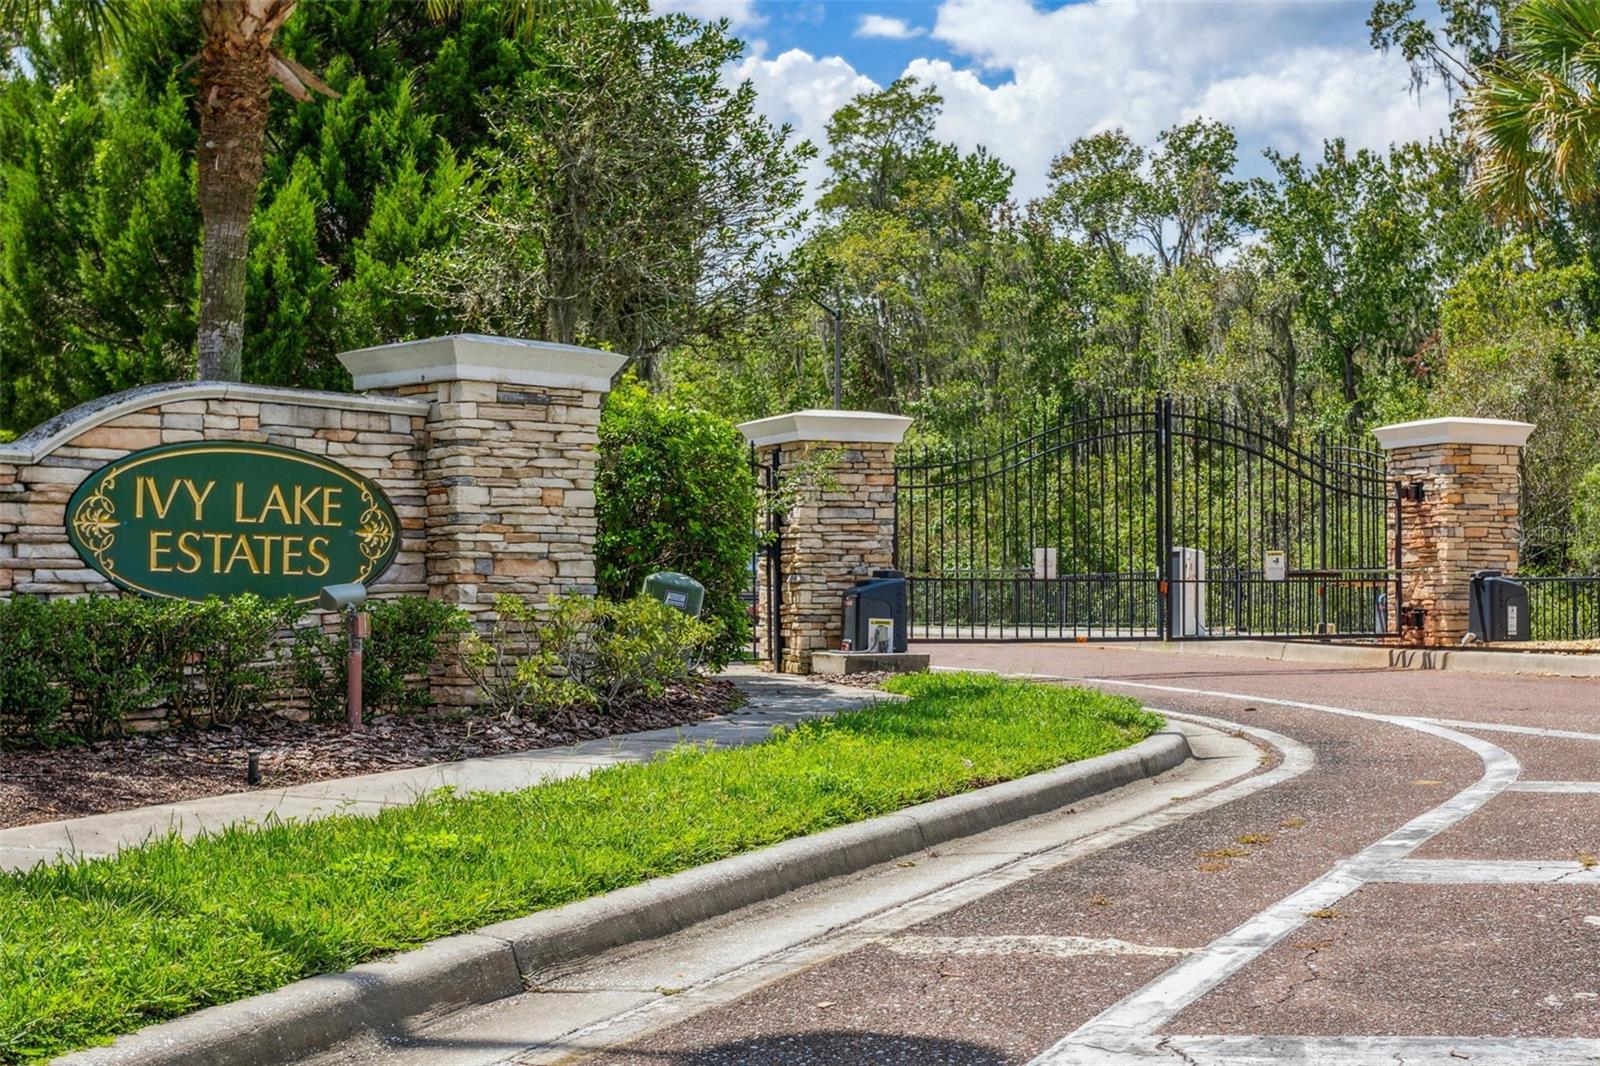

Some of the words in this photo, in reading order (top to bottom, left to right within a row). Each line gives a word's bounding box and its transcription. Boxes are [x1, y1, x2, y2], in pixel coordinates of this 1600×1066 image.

[135, 476, 216, 521] IVY
[235, 482, 343, 527] LAKE
[149, 530, 330, 577] ESTATES
